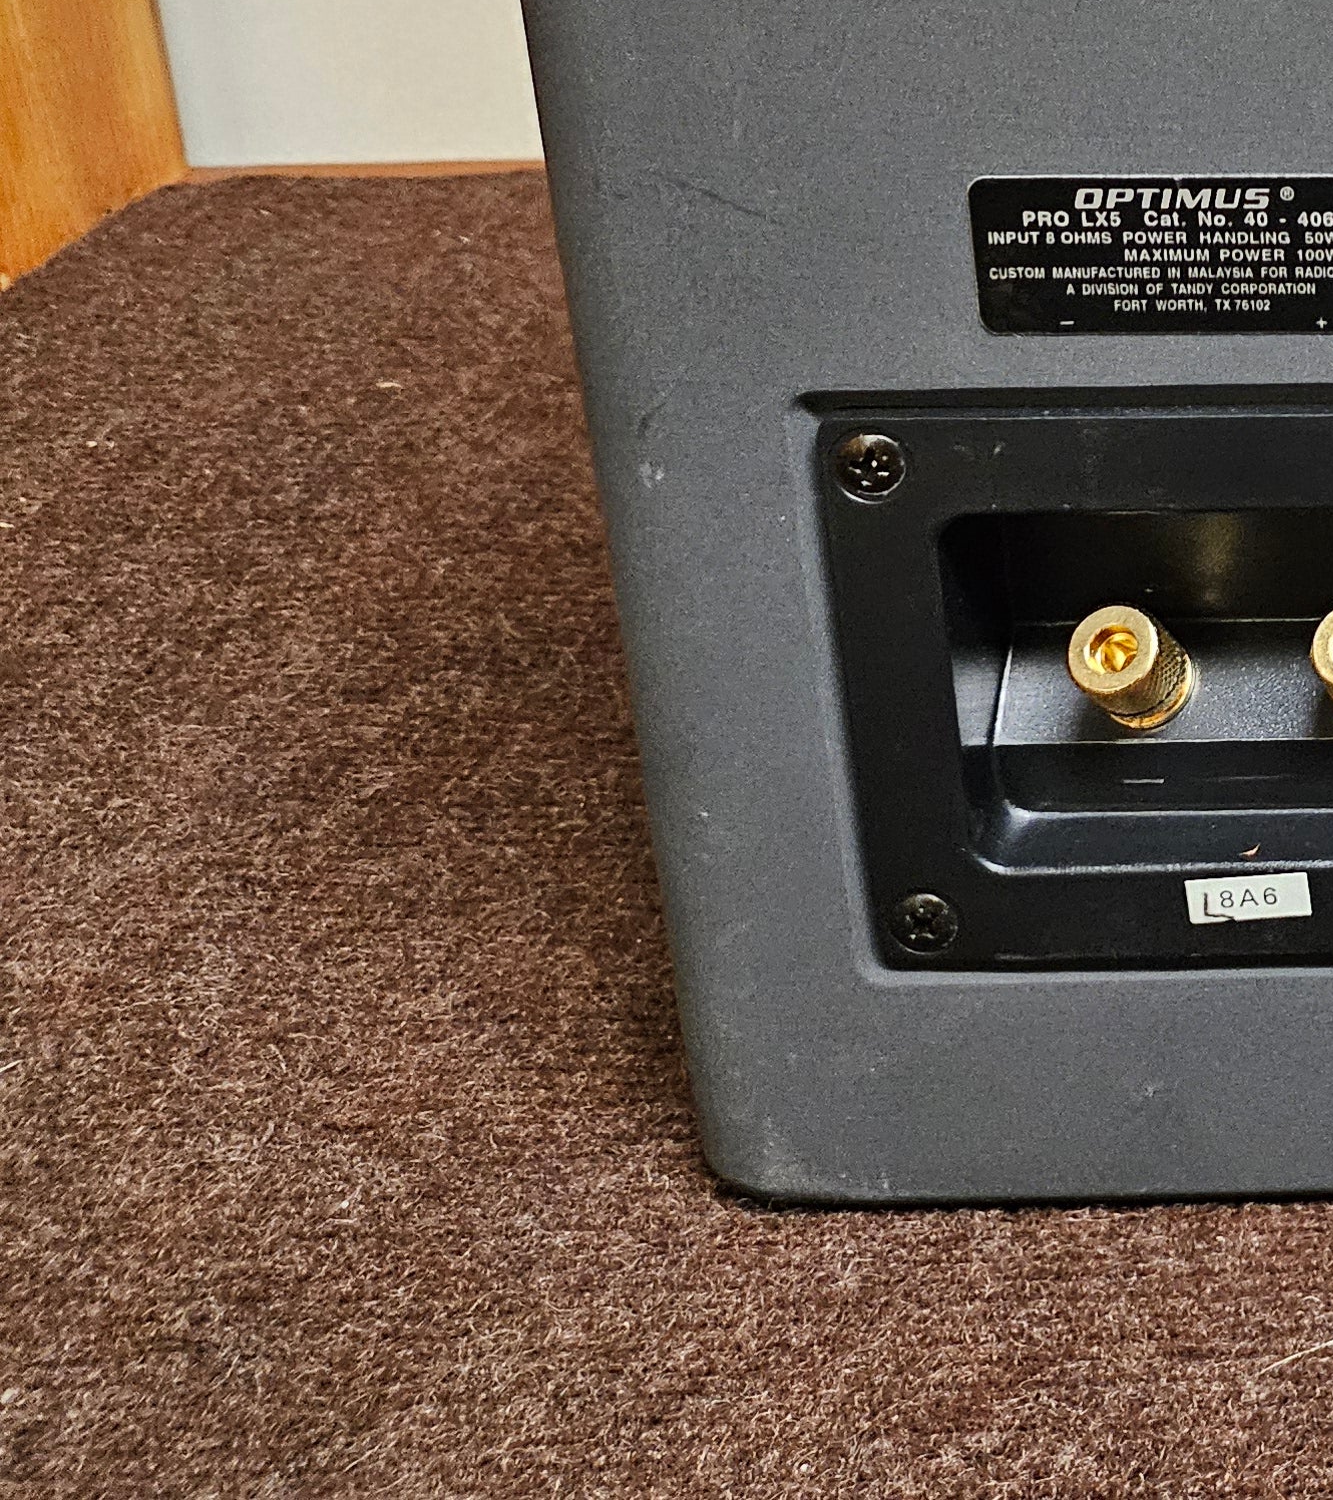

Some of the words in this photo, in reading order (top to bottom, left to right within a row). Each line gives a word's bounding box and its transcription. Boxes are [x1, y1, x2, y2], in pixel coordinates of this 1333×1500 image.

[1075, 189, 1269, 209] OPTIMUS
[1023, 211, 1069, 227] PRO
[1082, 211, 1121, 227] LX5
[1144, 211, 1186, 226] Cat.
[1198, 211, 1232, 226] No.
[1244, 212, 1267, 226] 40
[988, 232, 1039, 244] INPUT
[1046, 232, 1055, 244] 8
[1061, 232, 1112, 244] OHMS
[1123, 232, 1186, 244] POWER
[1200, 232, 1290, 244] HANDLING
[1125, 249, 1209, 261] MAXIMUM
[1220, 249, 1284, 261] POWER
[990, 267, 1045, 279] CUSTOM
[1053, 267, 1160, 278] MANUFACTURED
[1168, 267, 1180, 279] IN
[1188, 267, 1253, 278] MALAYSIA
[1261, 267, 1287, 278] FOR
[1067, 284, 1075, 295] A
[1083, 283, 1138, 295] DIVISION
[1146, 283, 1163, 294] OF
[1171, 283, 1213, 294] TANDY
[1221, 283, 1315, 294] CORPORATION
[1114, 300, 1147, 311] FORT
[1156, 299, 1207, 313] WORTH,
[1215, 299, 1230, 310] TX
[1235, 300, 1270, 311] 76102
[1220, 887, 1277, 907] 8A6
